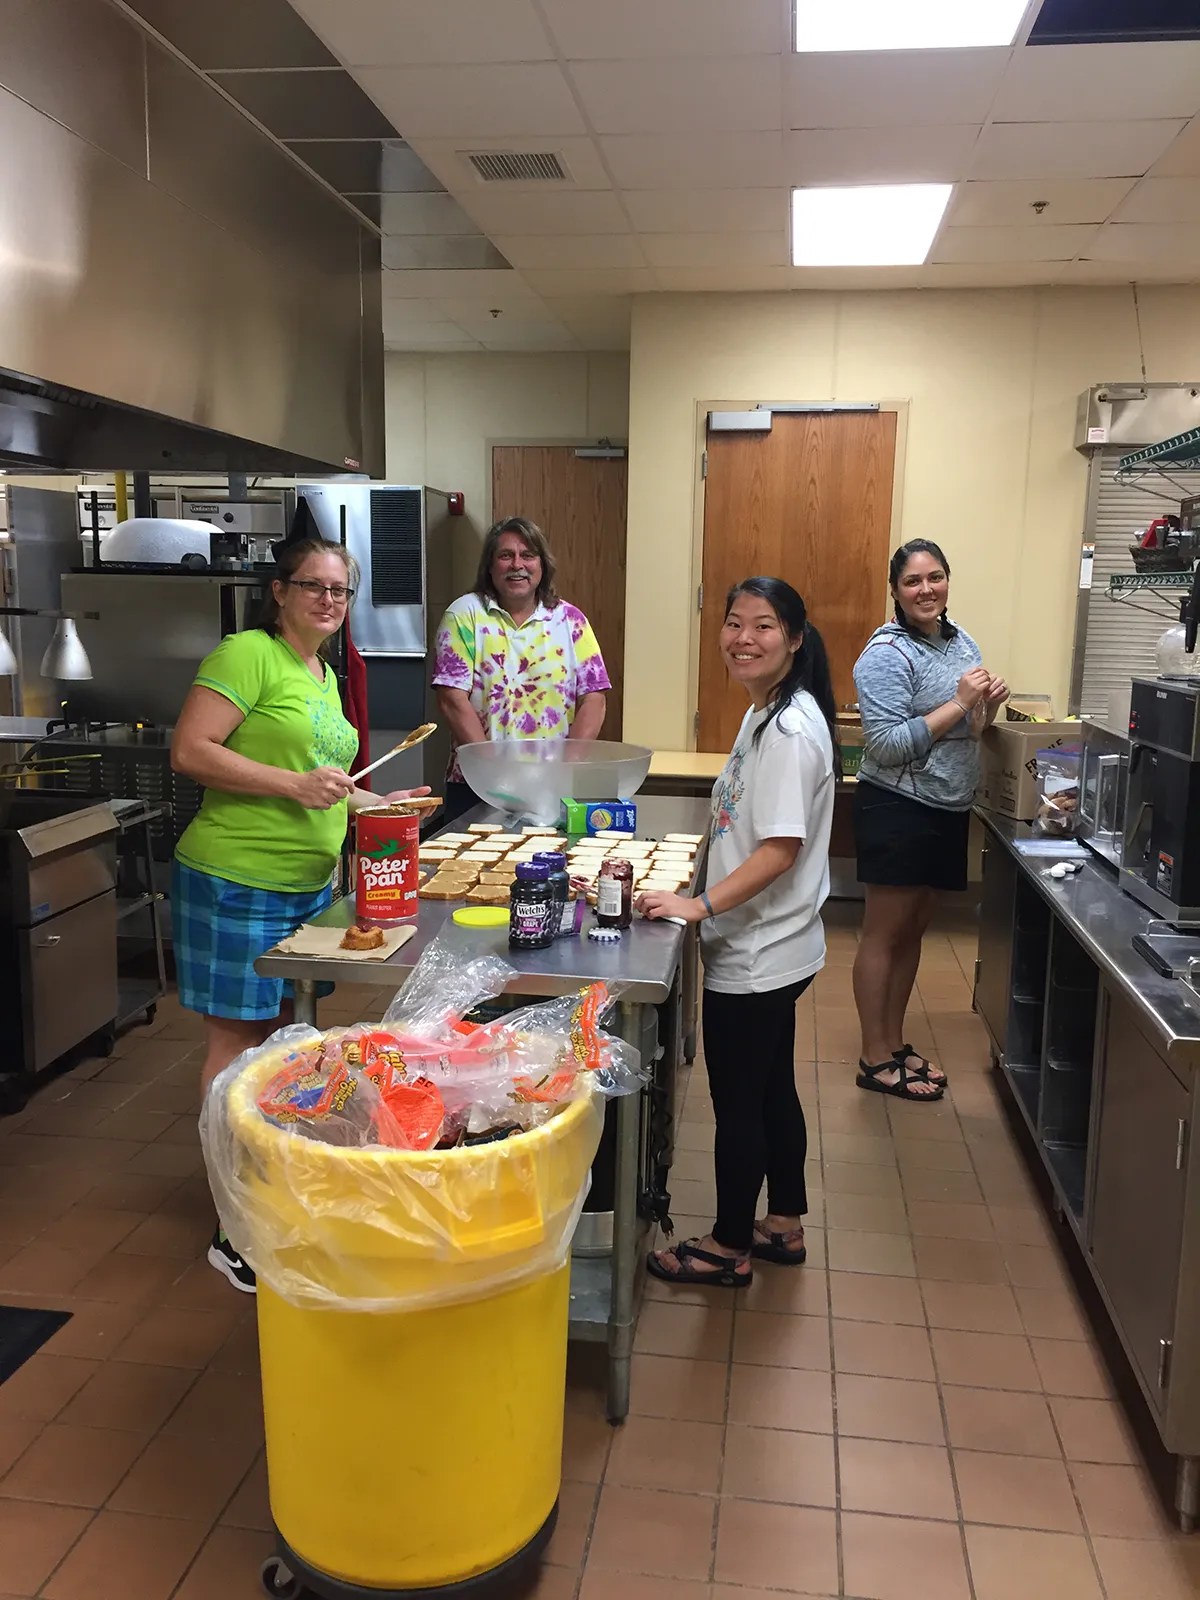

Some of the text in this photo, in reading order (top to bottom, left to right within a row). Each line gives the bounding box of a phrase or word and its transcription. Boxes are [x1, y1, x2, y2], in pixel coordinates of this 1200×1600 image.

[191, 504, 218, 512] Continental
[626, 809, 635, 828] Ziploc
[360, 856, 410, 874] Peter
[363, 872, 405, 891] Pan
[367, 890, 396, 899] Creamy
[517, 905, 546, 915] Welch's
[522, 920, 539, 928] GRAPE
